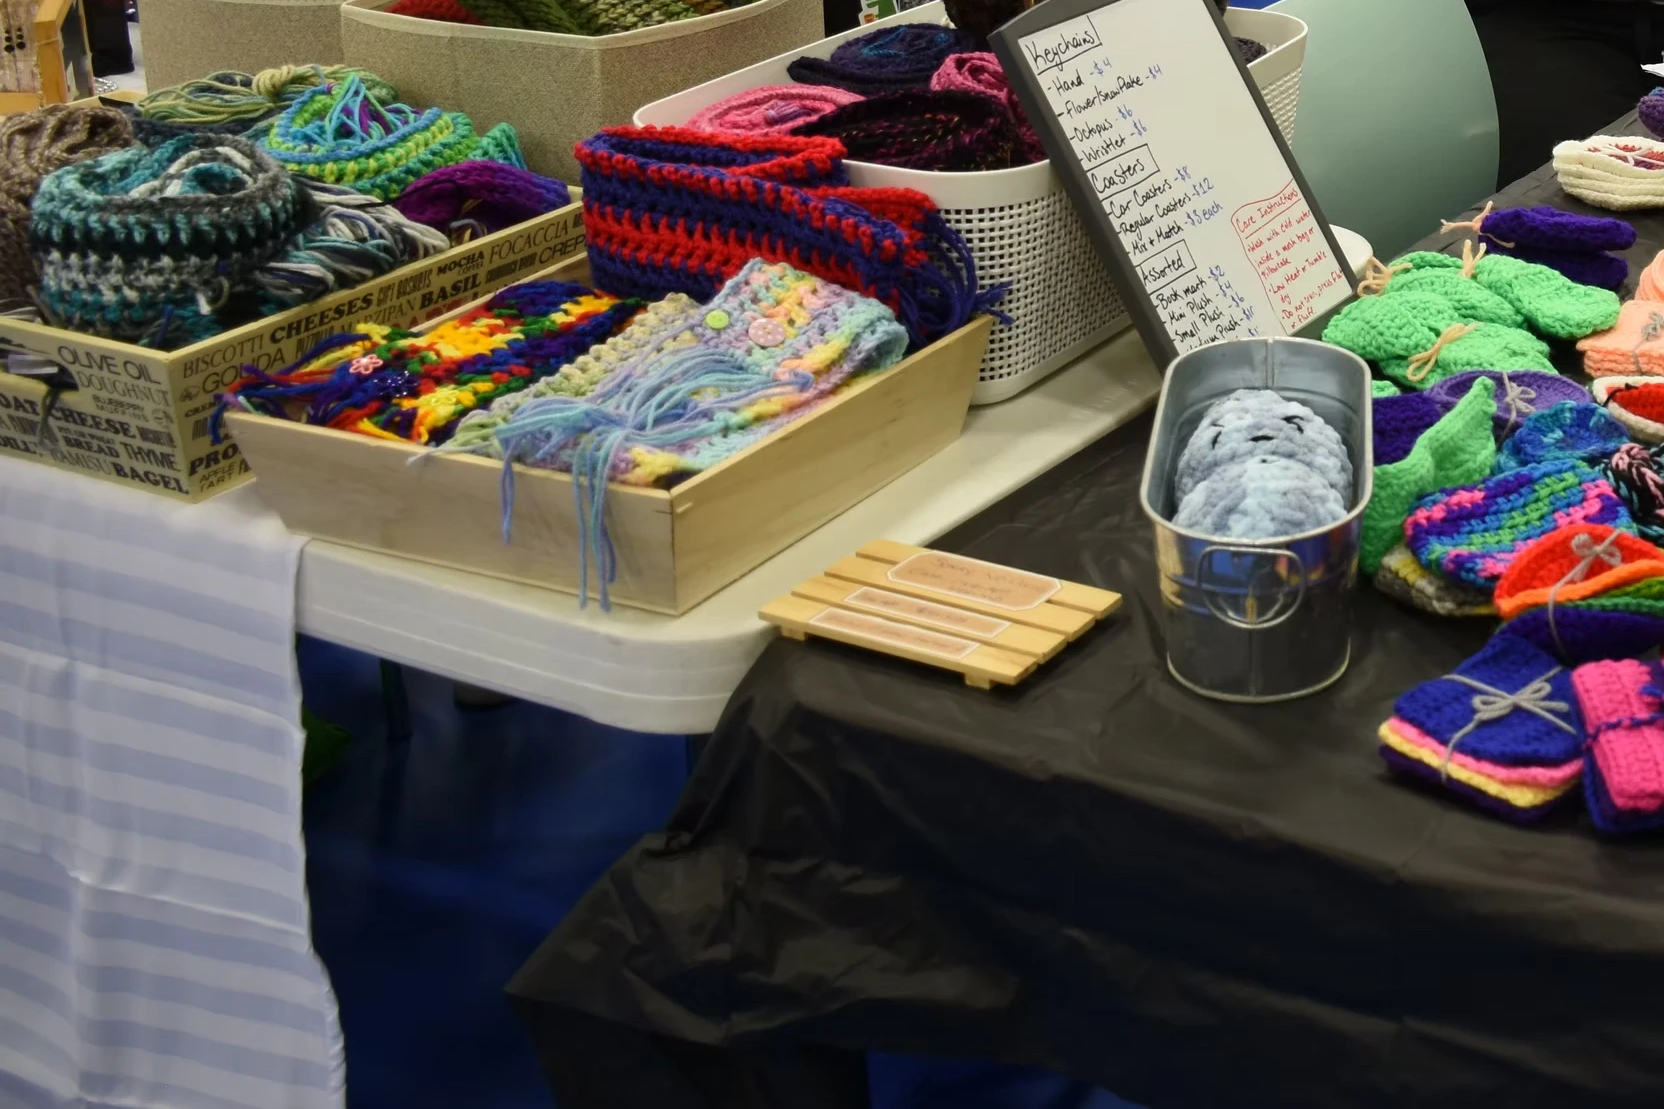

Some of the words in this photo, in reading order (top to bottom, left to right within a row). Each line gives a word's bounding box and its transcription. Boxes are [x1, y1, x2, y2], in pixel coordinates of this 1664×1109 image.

[1025, 31, 1096, 71] Keychains
[1091, 158, 1145, 194] Coasters
[1133, 178, 1173, 207] Coasters
[1155, 192, 1192, 219] Coasters
[1202, 201, 1224, 222] each
[1235, 215, 1256, 234] Care
[1257, 188, 1299, 219] Instructions
[1267, 229, 1280, 242] with
[1296, 209, 1311, 225] water
[1256, 251, 1274, 268] inside
[1282, 240, 1297, 252] mesh
[1297, 231, 1310, 246] bag
[1308, 226, 1315, 237] or
[458, 259, 485, 276] COFFEE
[1140, 249, 1185, 286] Assorted
[1284, 268, 1301, 284] Heat
[1305, 250, 1328, 268] Tumble
[182, 334, 264, 379] BISCOTTI
[269, 293, 374, 344] CHEESES
[436, 250, 486, 276] MOCHA
[489, 219, 569, 264] FOCACCIA
[1187, 292, 1214, 314] Plush
[1281, 294, 1292, 305] dry
[1283, 309, 1294, 320] Do
[1295, 301, 1305, 313] not
[202, 347, 286, 392] GOUDA
[419, 273, 482, 311] BASIL
[57, 345, 121, 376] OLIVE
[123, 360, 161, 385] OIL
[77, 370, 170, 407] DOUGHNUT
[50, 406, 137, 439] CHEESE
[95, 402, 150, 423] MUFFINS
[61, 435, 120, 459] BREAD
[120, 441, 182, 473] THYME
[188, 443, 240, 477] PRO
[110, 461, 190, 495] BAGEL
[200, 460, 235, 484] APPLE
[200, 473, 233, 493] TART
